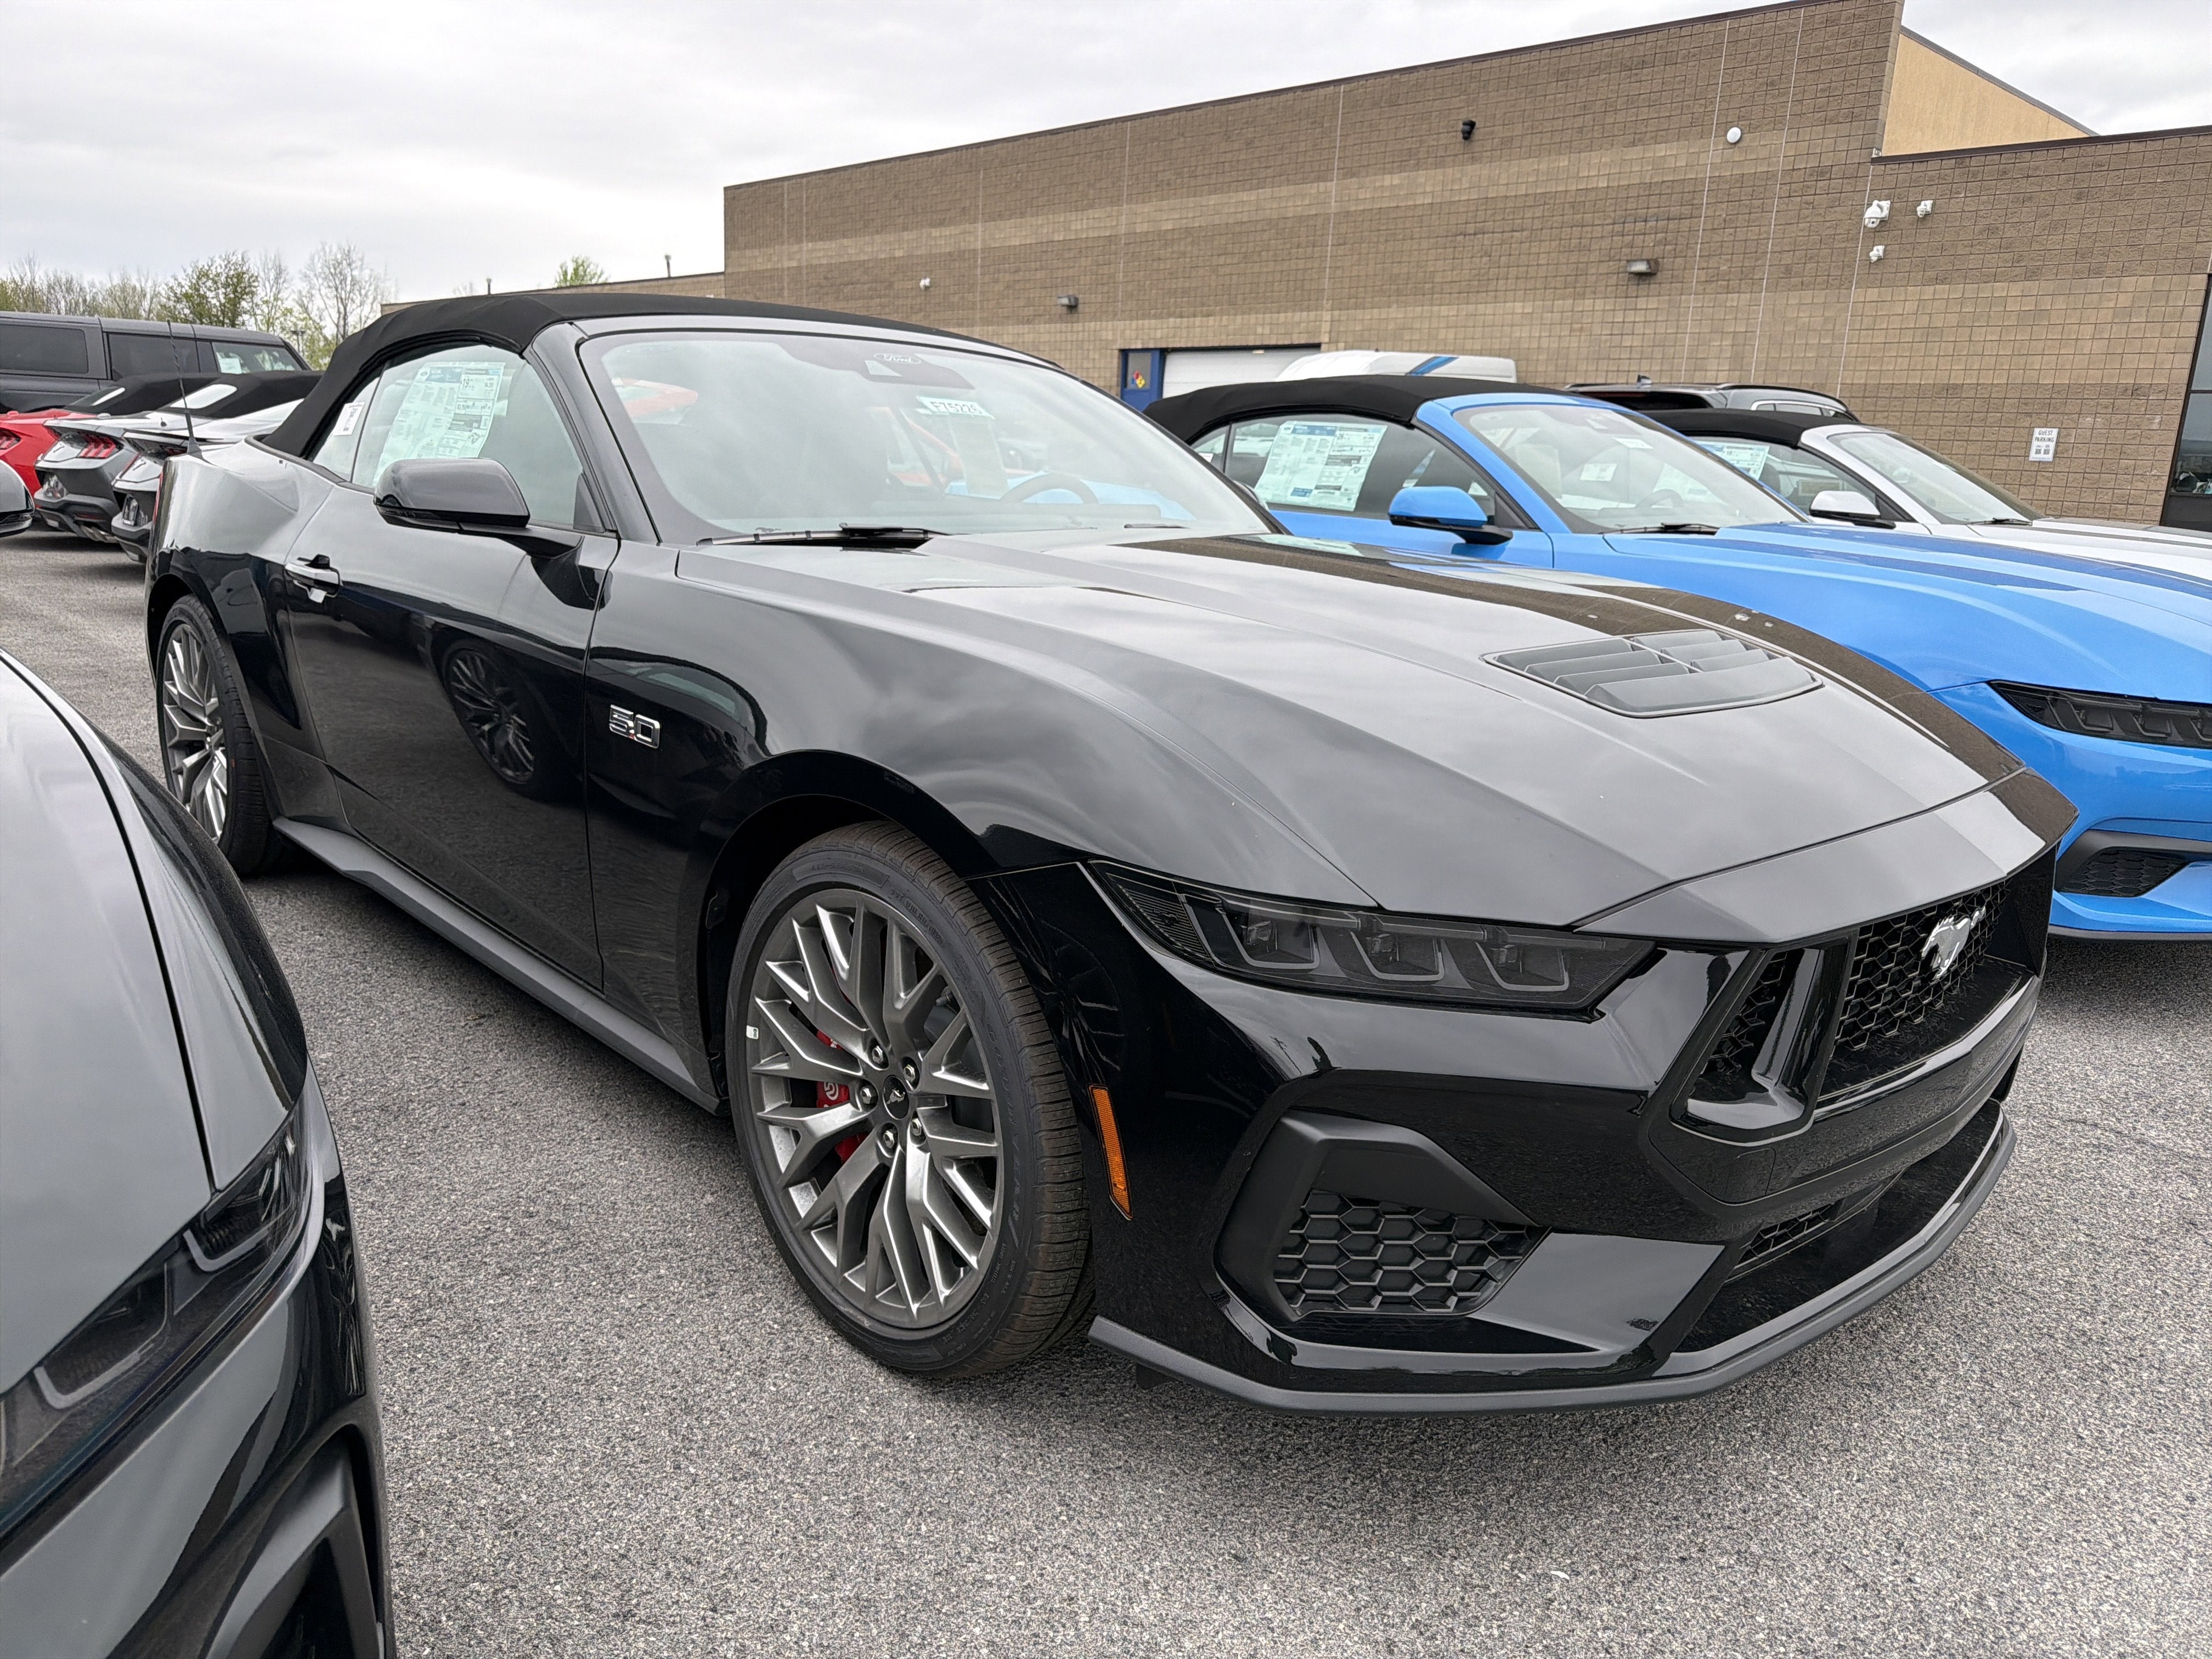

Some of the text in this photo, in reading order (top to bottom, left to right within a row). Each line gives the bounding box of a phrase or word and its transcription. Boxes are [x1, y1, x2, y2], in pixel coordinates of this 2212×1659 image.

[883, 354, 914, 363] Ford
[930, 401, 982, 414] F75226
[609, 704, 661, 749] 5.0
